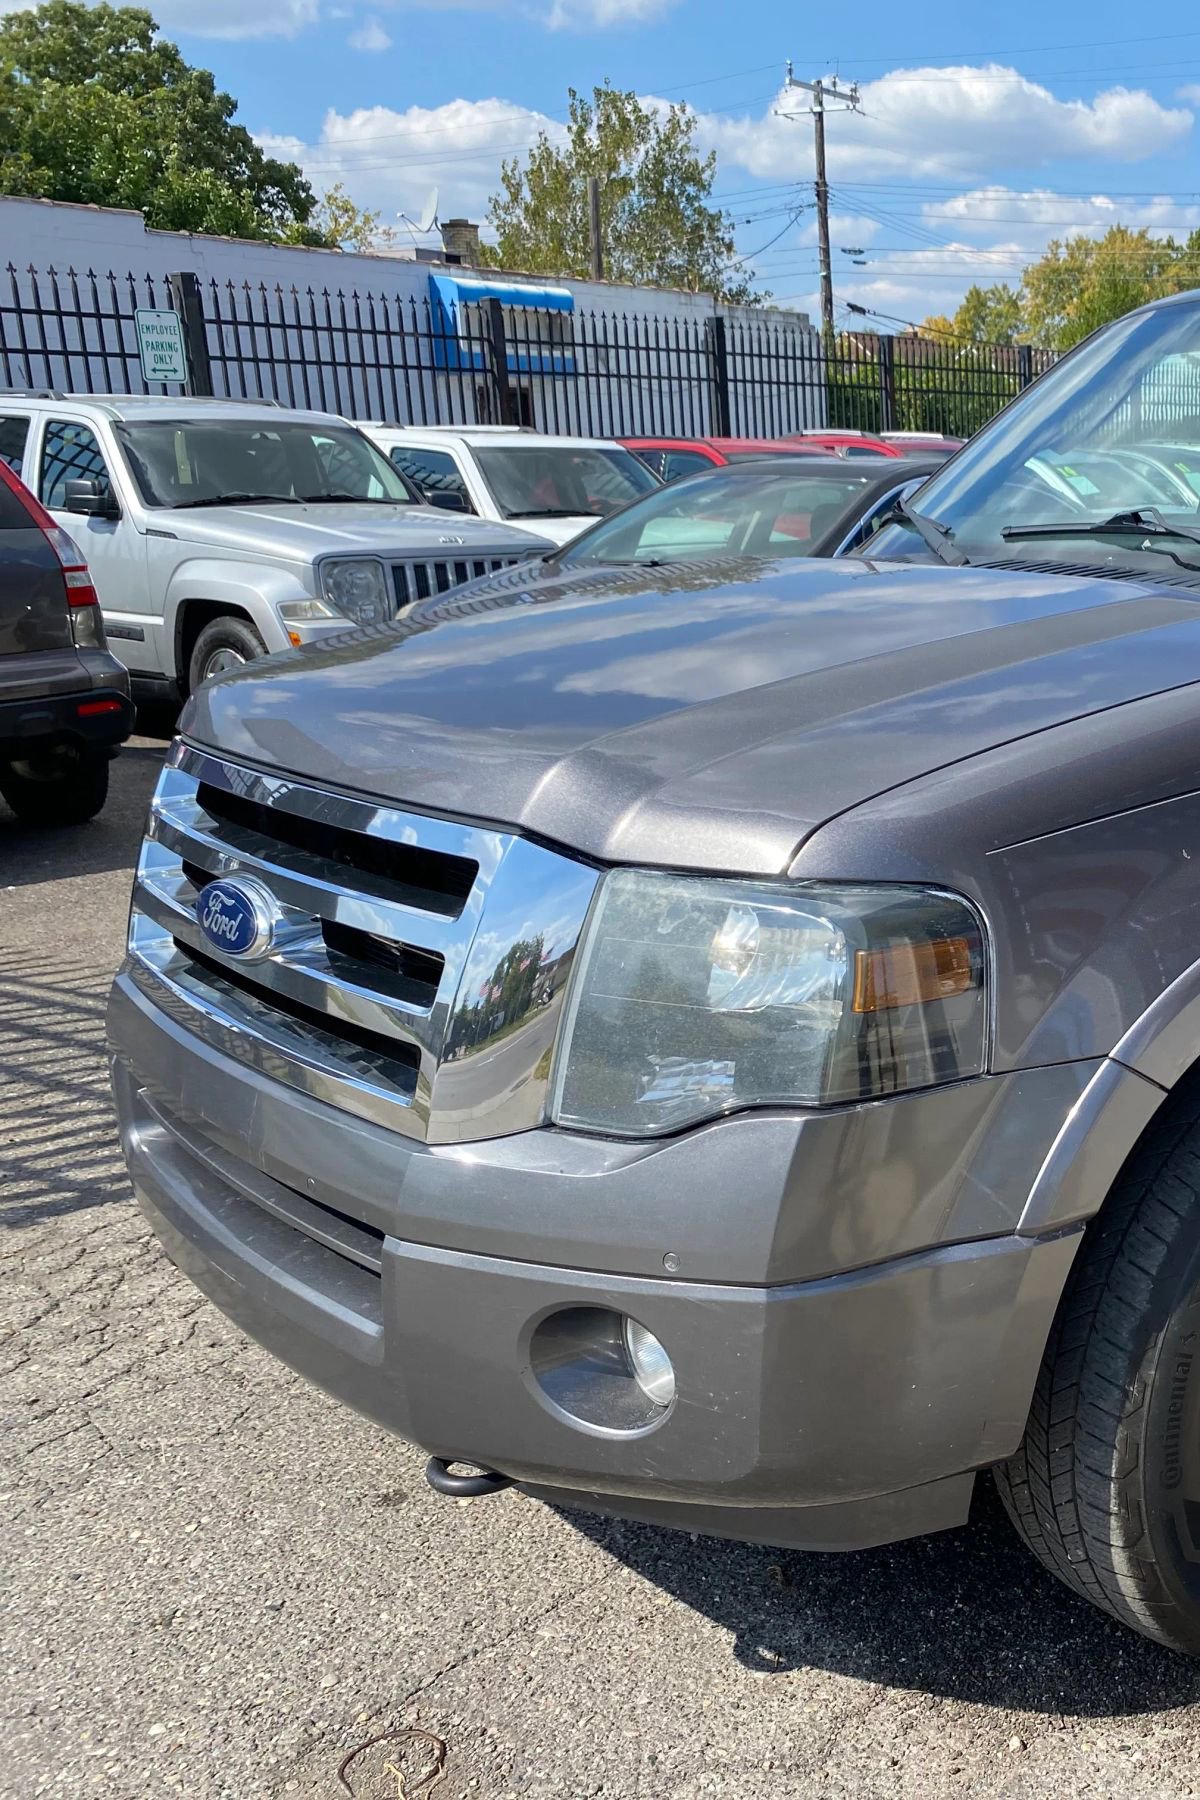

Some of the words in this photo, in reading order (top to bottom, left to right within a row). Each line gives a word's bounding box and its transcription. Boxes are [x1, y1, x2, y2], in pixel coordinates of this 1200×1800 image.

[141, 323, 178, 335] EMPLOYEE
[145, 340, 178, 352] PARKING
[153, 353, 173, 365] ONLY
[203, 890, 243, 941] Ford
[1160, 1352, 1193, 1489] Continental
